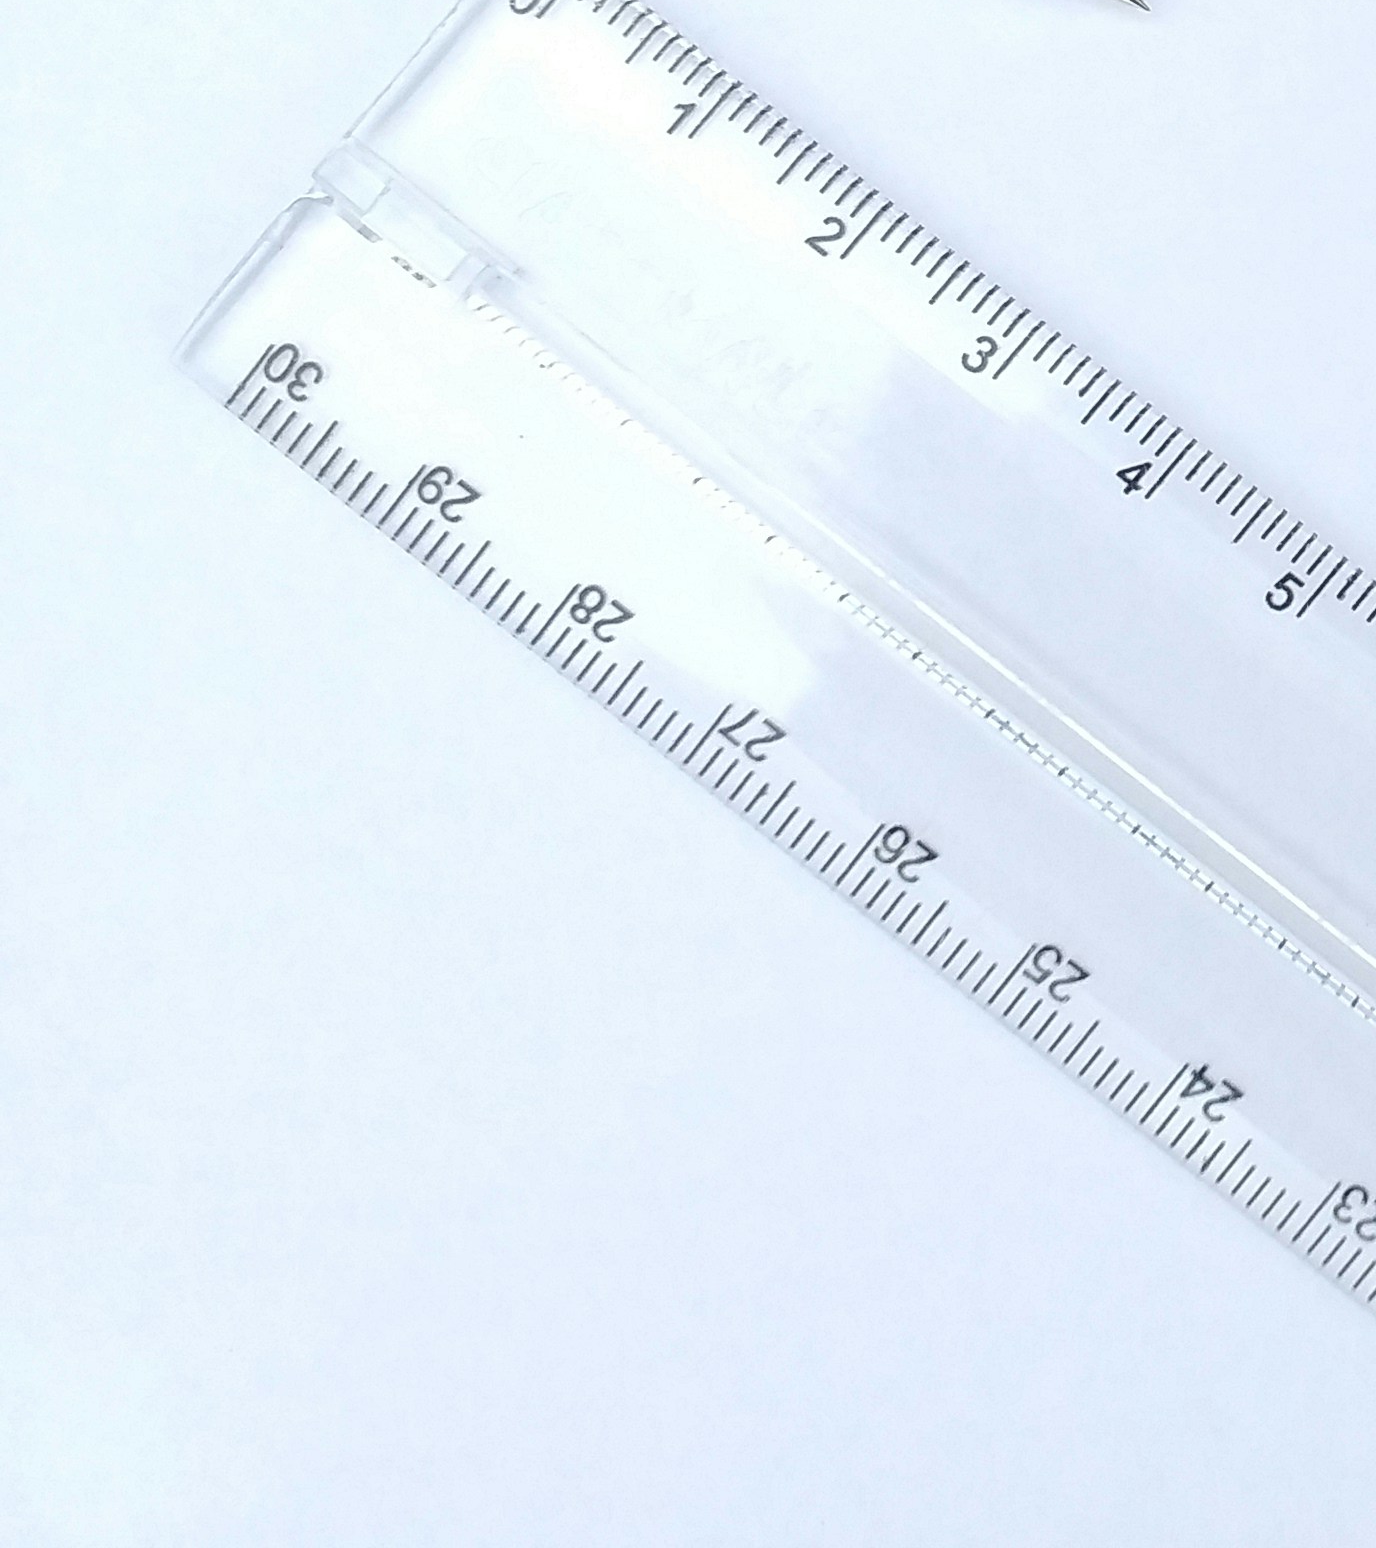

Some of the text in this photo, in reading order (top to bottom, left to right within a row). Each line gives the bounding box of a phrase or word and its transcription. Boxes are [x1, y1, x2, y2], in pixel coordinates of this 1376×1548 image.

[263, 343, 324, 403] 30
[667, 102, 698, 135] 1
[804, 216, 846, 256] 2
[961, 336, 999, 373] 3
[1116, 461, 1153, 495] 4
[1265, 571, 1305, 611] 5
[417, 464, 482, 524] 29
[569, 584, 636, 644] 28
[718, 709, 788, 763] 27
[874, 823, 940, 884] 26
[1022, 944, 1091, 1003] 25
[1179, 1064, 1245, 1123] 24
